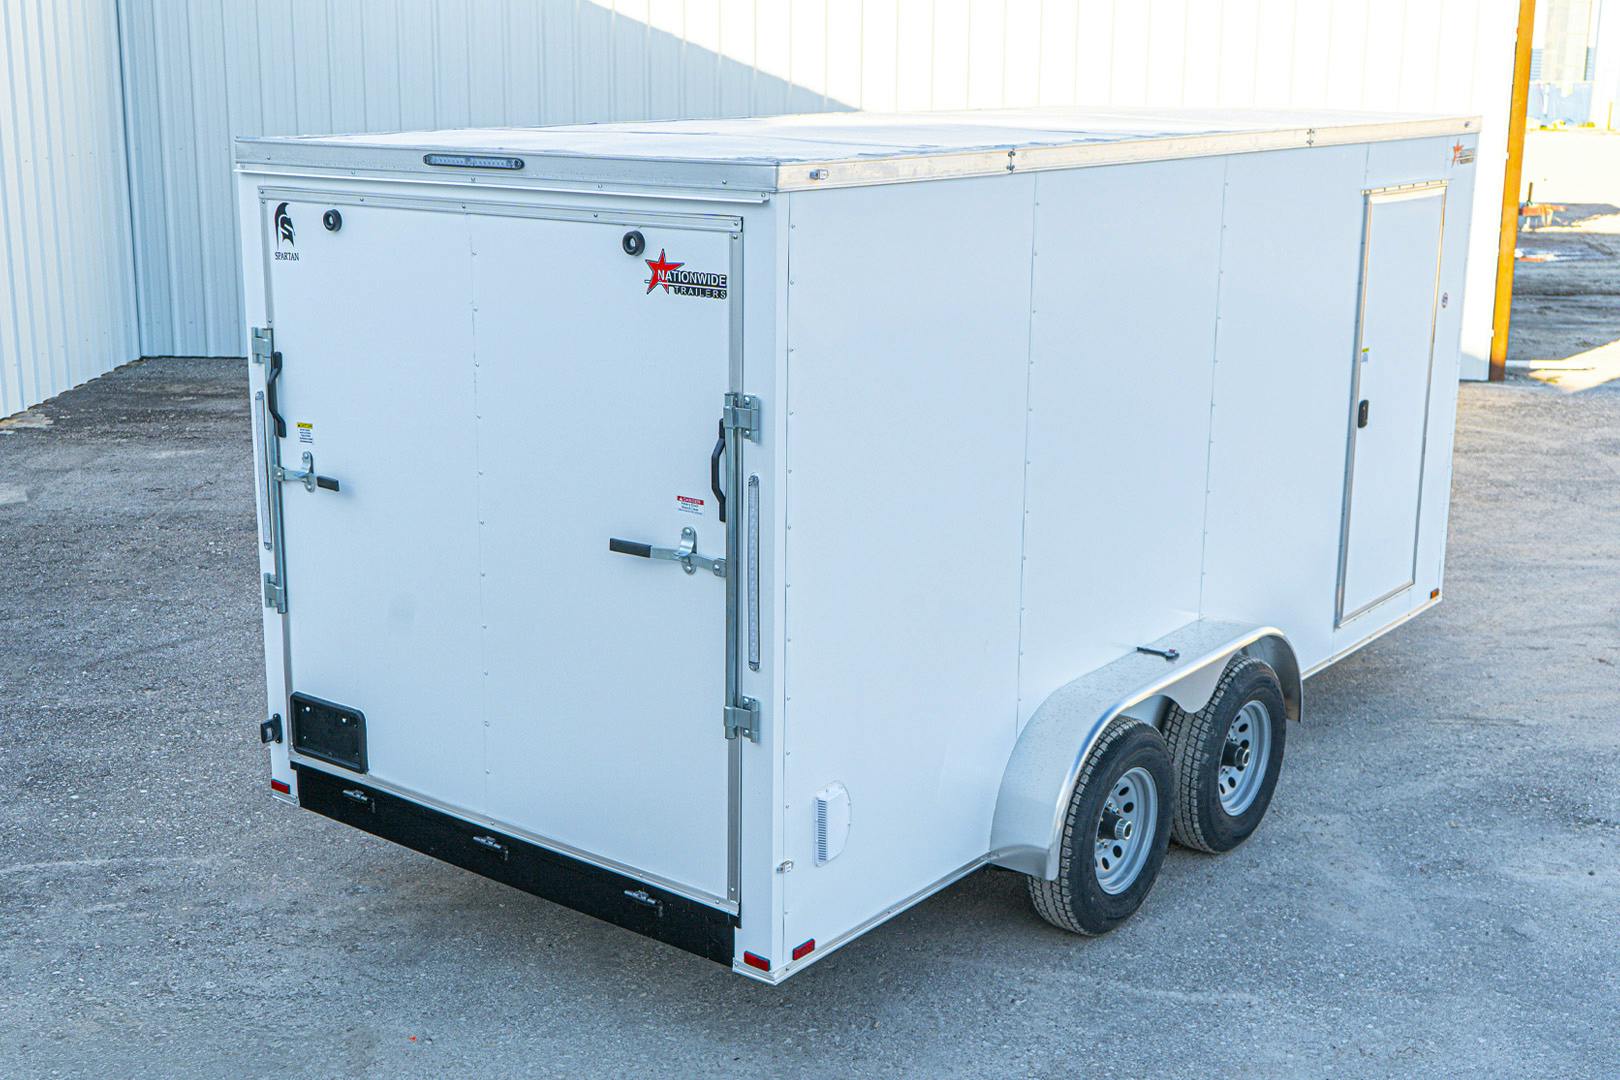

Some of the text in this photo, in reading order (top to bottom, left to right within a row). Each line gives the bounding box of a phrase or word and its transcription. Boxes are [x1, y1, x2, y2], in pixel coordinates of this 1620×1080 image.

[274, 251, 300, 261] SPARTAN
[657, 269, 726, 287] NATIONWIDE
[675, 286, 726, 299] TRAILERS
